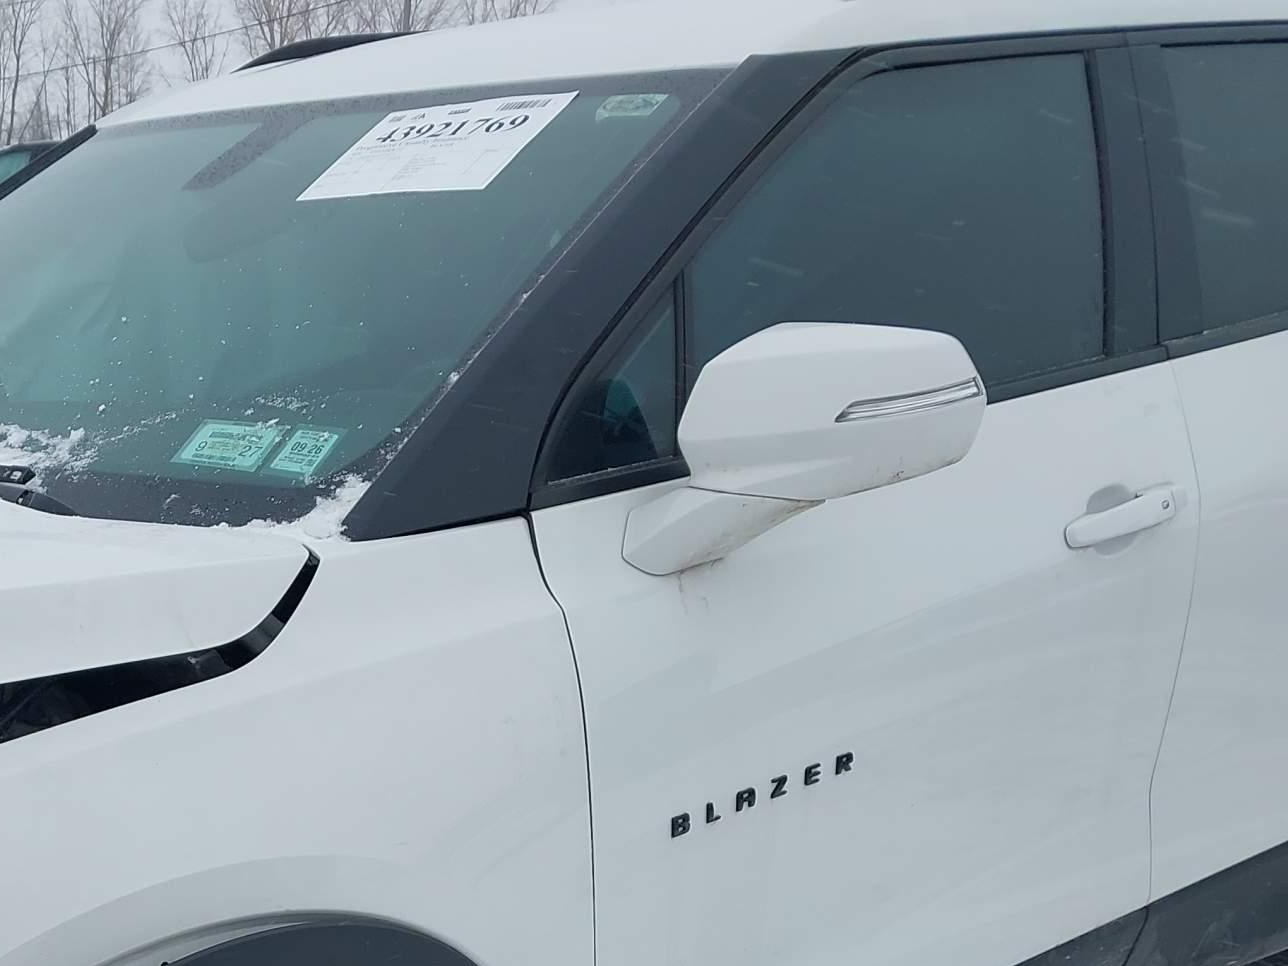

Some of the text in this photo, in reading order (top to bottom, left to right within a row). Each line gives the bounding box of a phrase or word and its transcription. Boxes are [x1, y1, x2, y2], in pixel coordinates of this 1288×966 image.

[376, 114, 530, 143] 43921769
[195, 440, 208, 452] 9
[238, 445, 264, 458] 27
[291, 441, 325, 455] 09 26
[670, 751, 855, 839] BLAZER
